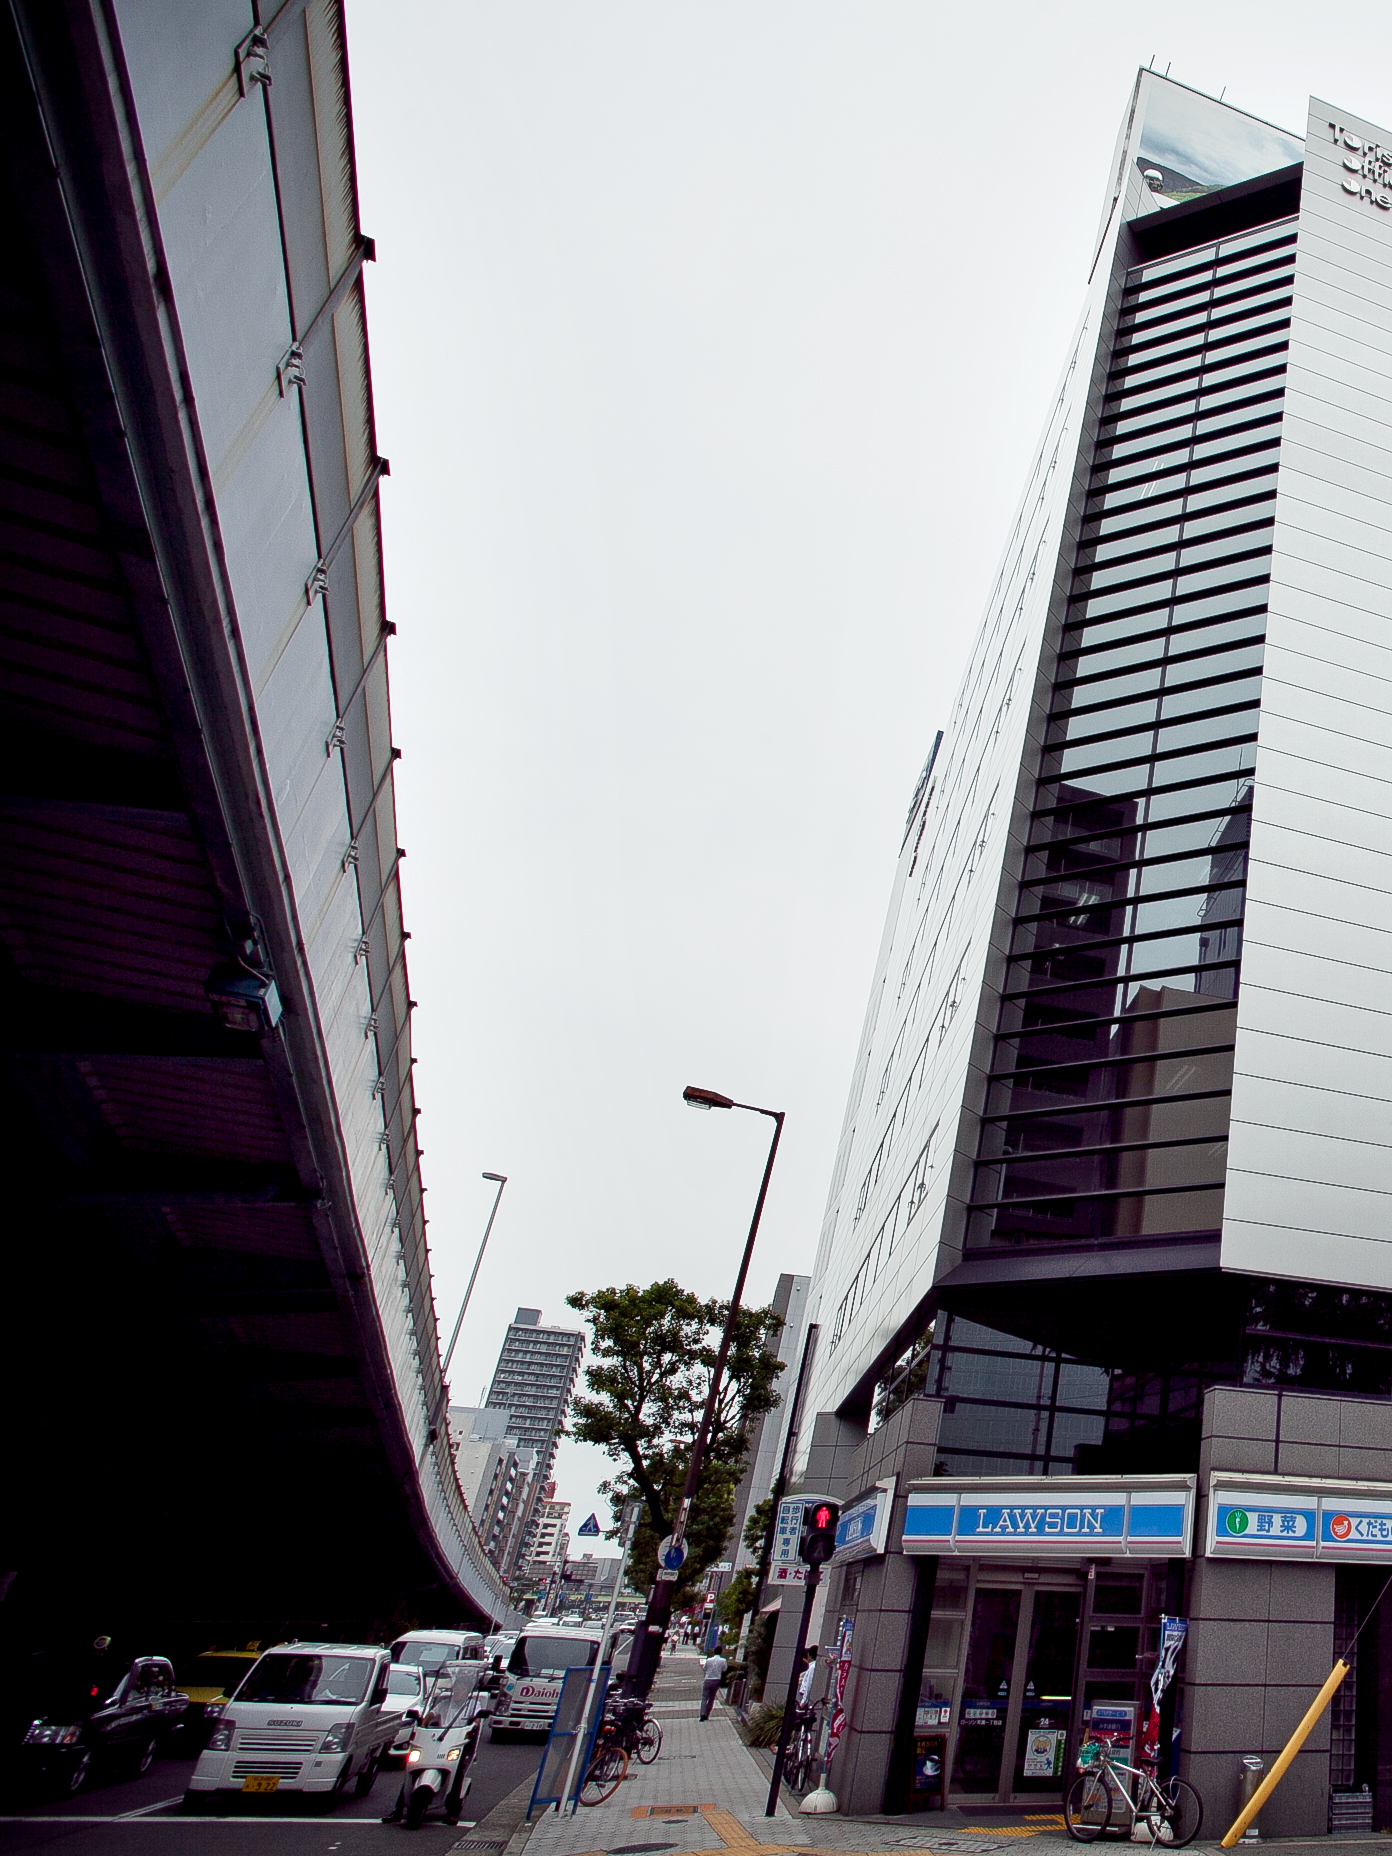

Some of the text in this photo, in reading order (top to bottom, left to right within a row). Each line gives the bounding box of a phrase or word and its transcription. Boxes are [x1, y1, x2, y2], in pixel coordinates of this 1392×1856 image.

[1341, 178, 1392, 211] One
[779, 1505, 791, 1535] 自転車
[788, 1505, 801, 1535] 歩行者
[976, 1508, 1104, 1533] LAWSON
[1256, 1514, 1297, 1534] 野菜
[780, 1538, 791, 1558] 専用
[706, 1593, 714, 1603] P
[268, 1719, 303, 1727] SUZUKI
